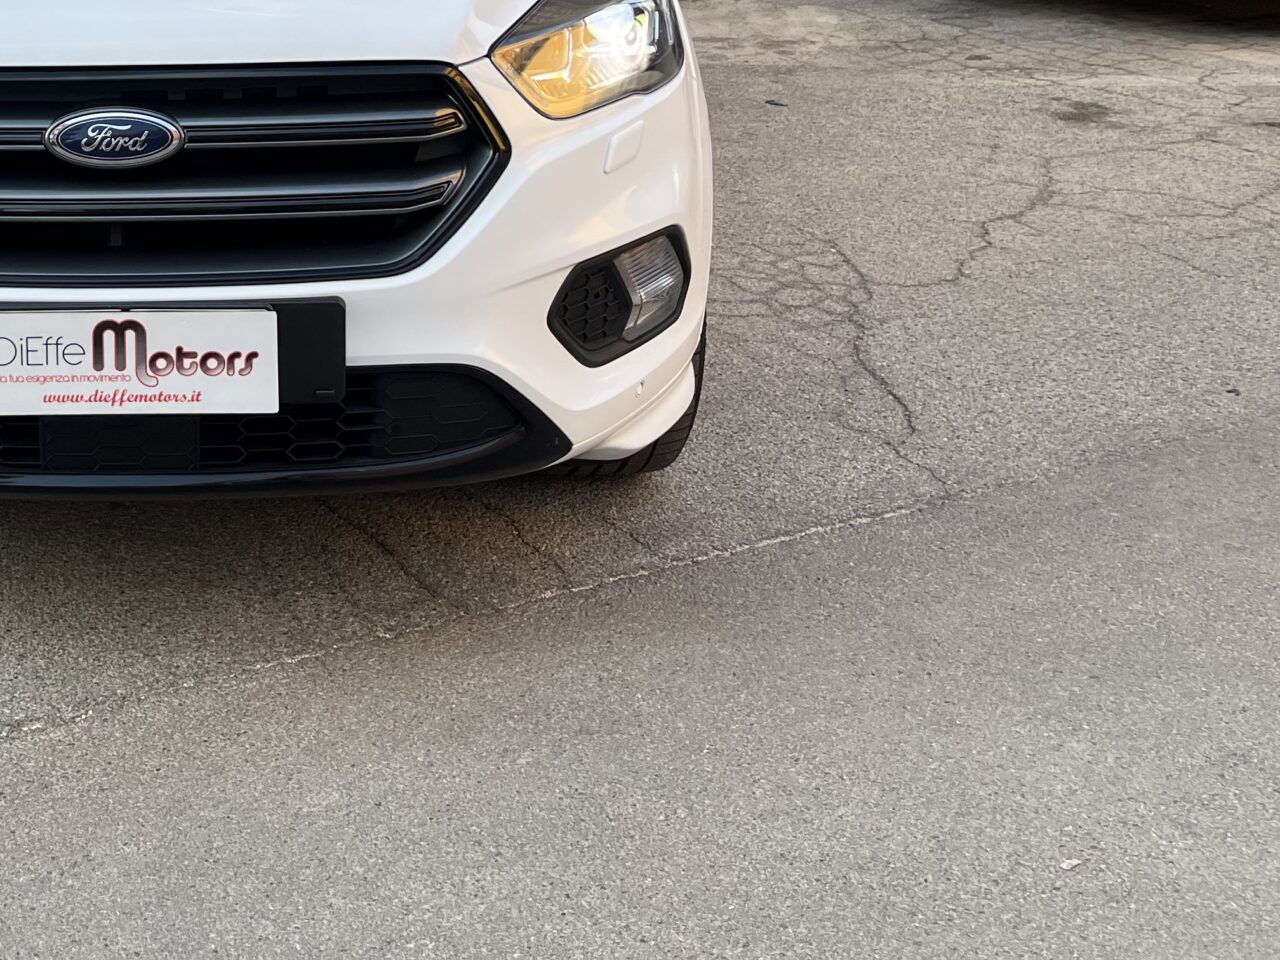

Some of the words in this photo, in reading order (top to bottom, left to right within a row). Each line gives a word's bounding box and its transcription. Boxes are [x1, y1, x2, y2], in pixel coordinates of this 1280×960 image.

[81, 123, 149, 152] Ford
[92, 319, 260, 387] Motors
[8, 374, 25, 384] tua
[26, 374, 70, 385] esigenza
[71, 374, 79, 383] in
[81, 373, 132, 383] movimento
[42, 389, 203, 407] www.dieffemotors.it
